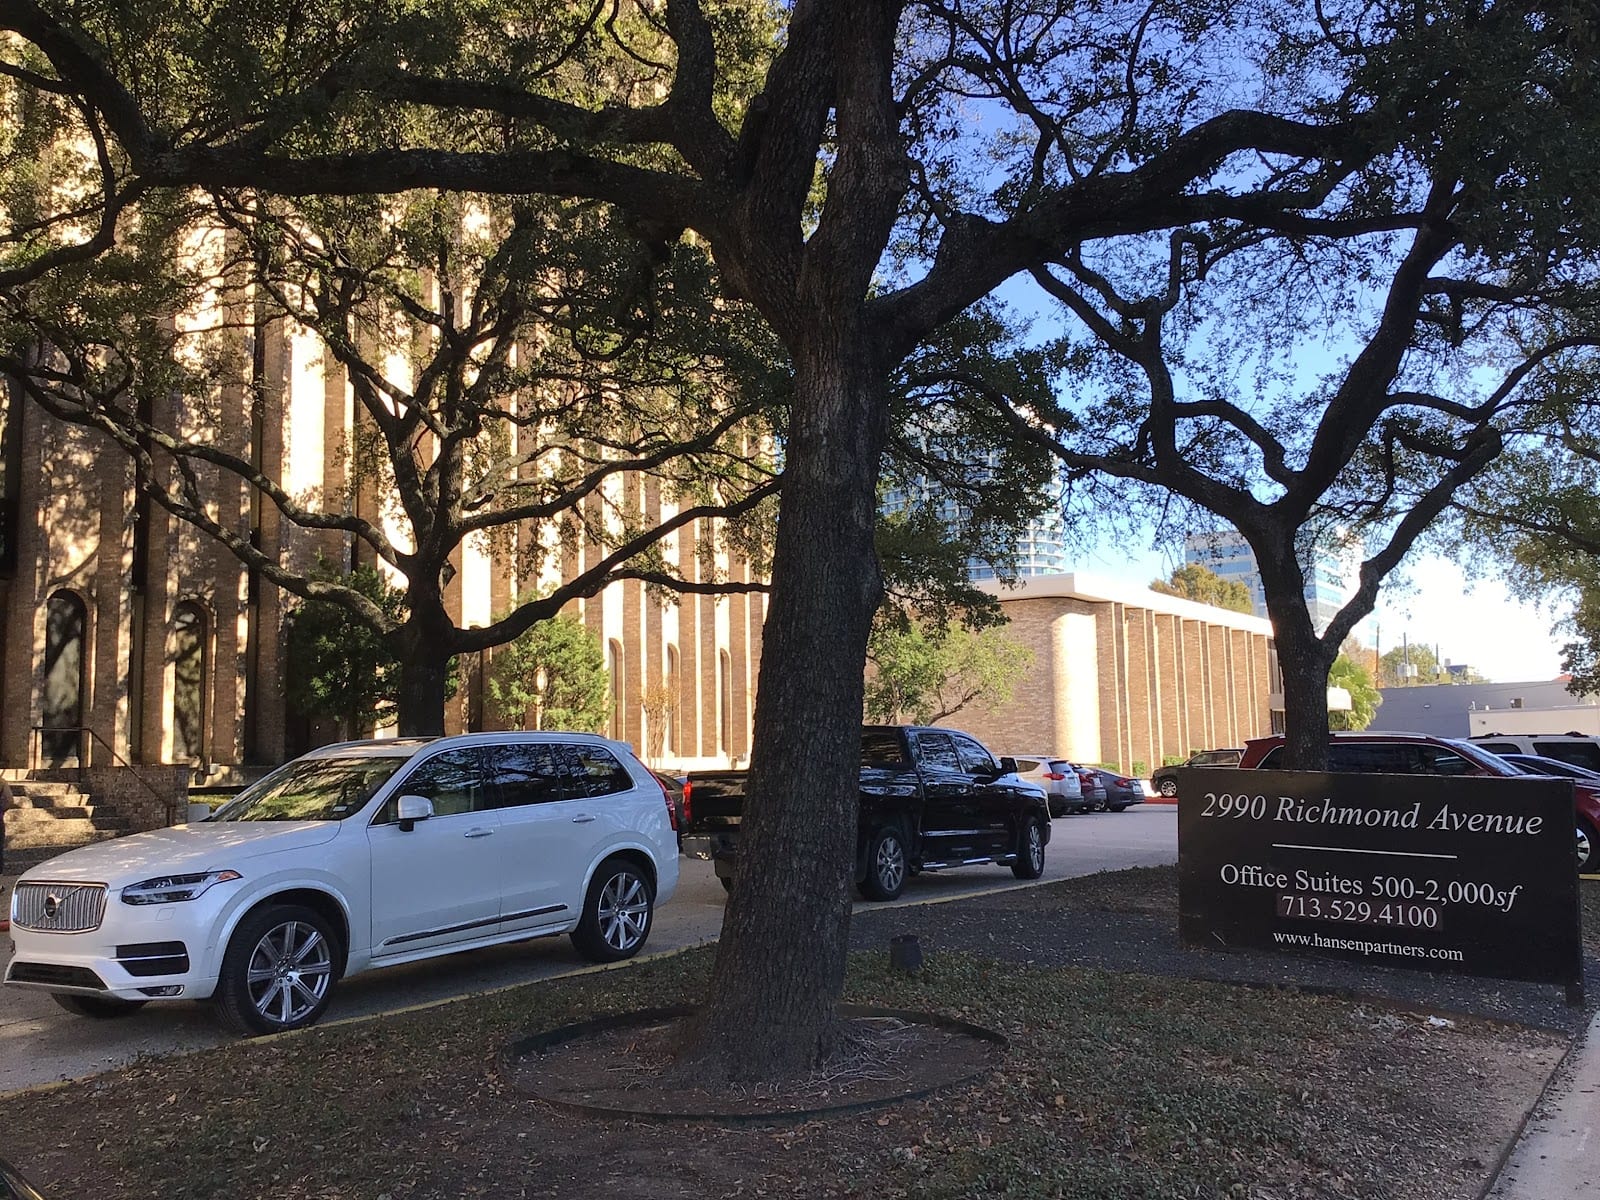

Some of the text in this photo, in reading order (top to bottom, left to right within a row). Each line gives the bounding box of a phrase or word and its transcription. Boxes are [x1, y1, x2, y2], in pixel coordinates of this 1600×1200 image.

[1200, 792, 1543, 835] 2990 Richmond Avenue
[1220, 863, 1523, 913] Office Suites 500-2,000sf
[1281, 895, 1437, 928] 713.529.4100
[1272, 932, 1464, 961] www.hansenpartners.com
